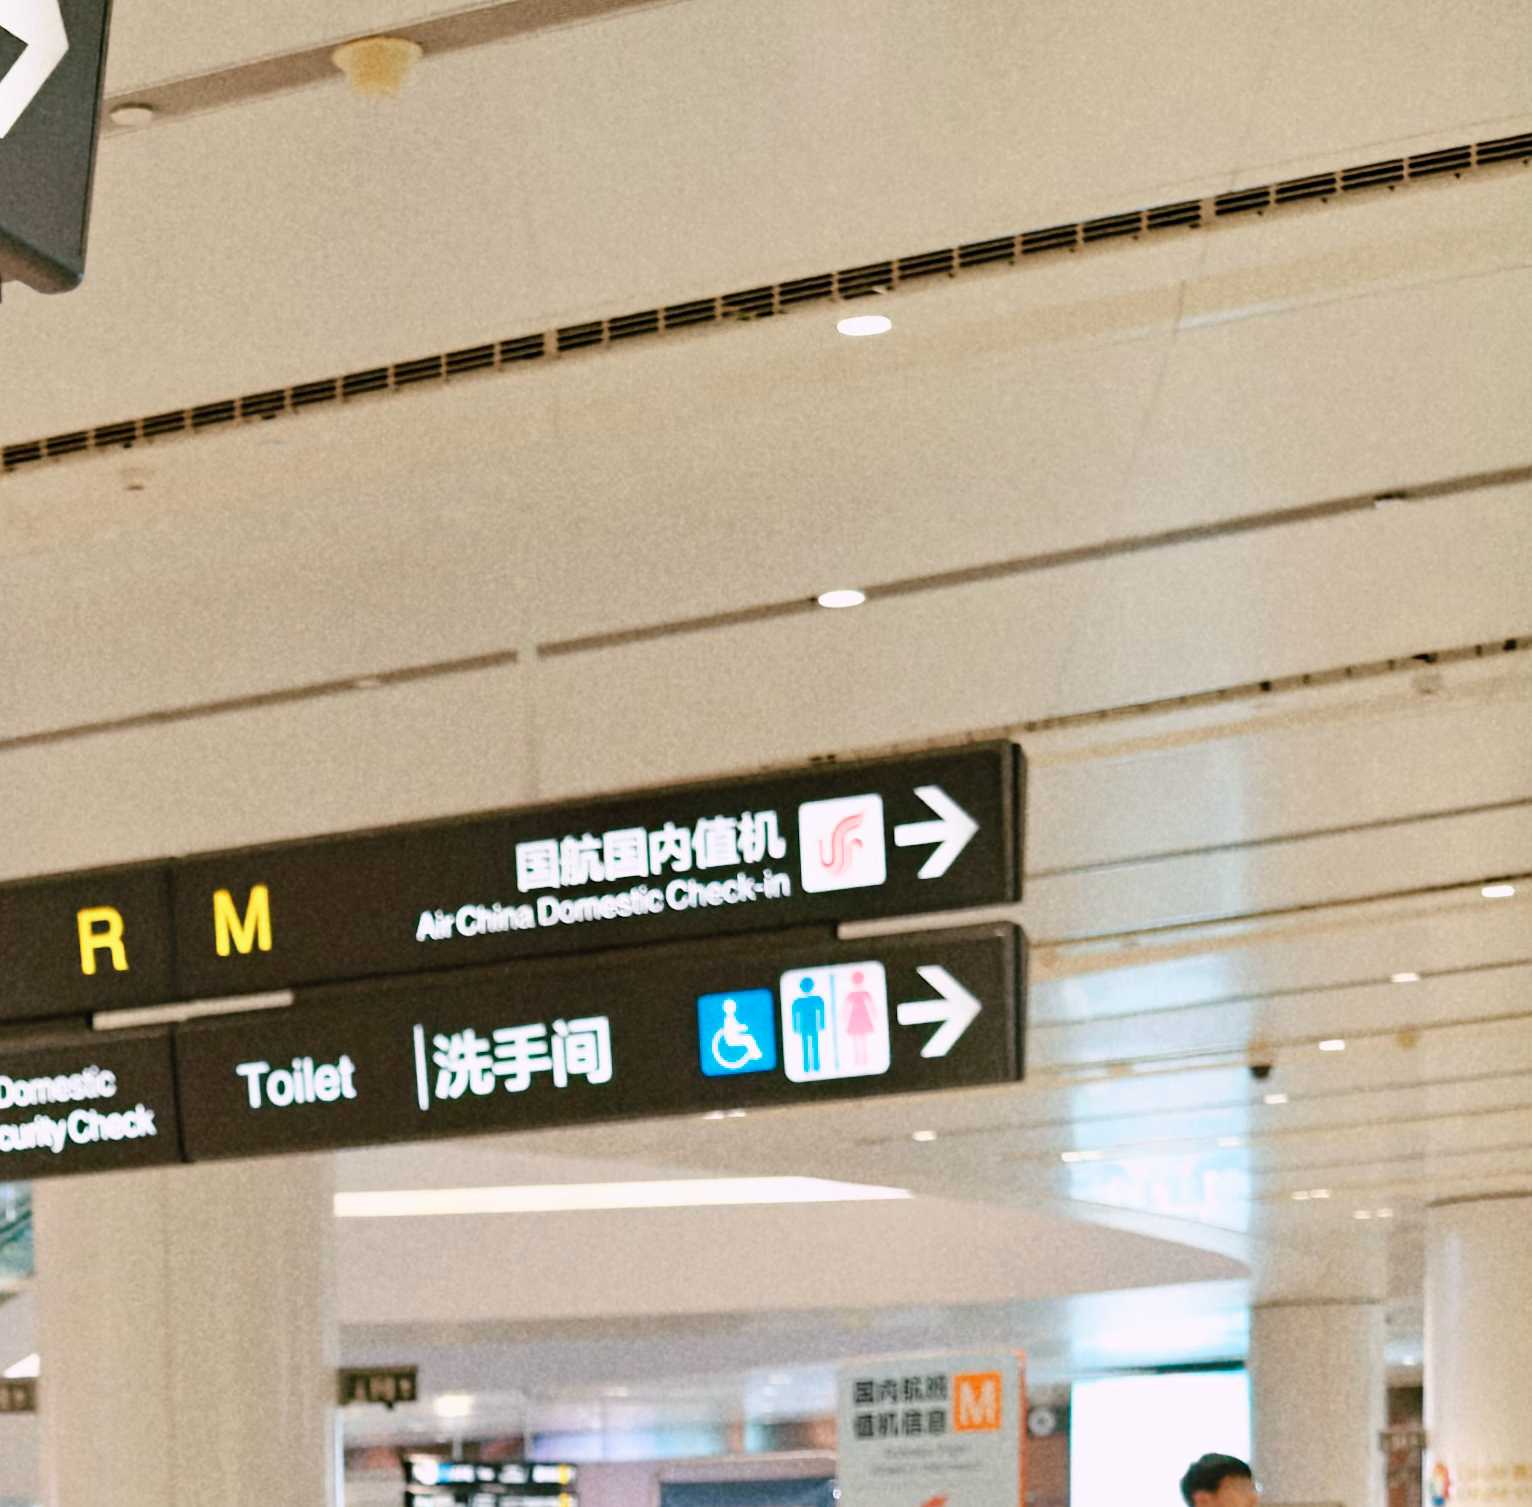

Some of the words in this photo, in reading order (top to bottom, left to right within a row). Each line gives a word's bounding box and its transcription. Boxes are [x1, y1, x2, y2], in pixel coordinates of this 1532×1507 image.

[516, 811, 787, 892] 国航国内值机
[213, 885, 272, 957] M
[416, 910, 452, 941] Air
[455, 903, 535, 936] China
[537, 885, 664, 926] Domestic
[666, 869, 791, 910] Check-in
[77, 907, 128, 975] R
[236, 1056, 357, 1109] Toilet
[433, 1017, 613, 1099] 洗手间
[67, 1104, 157, 1144] Check
[958, 1379, 997, 1427] M
